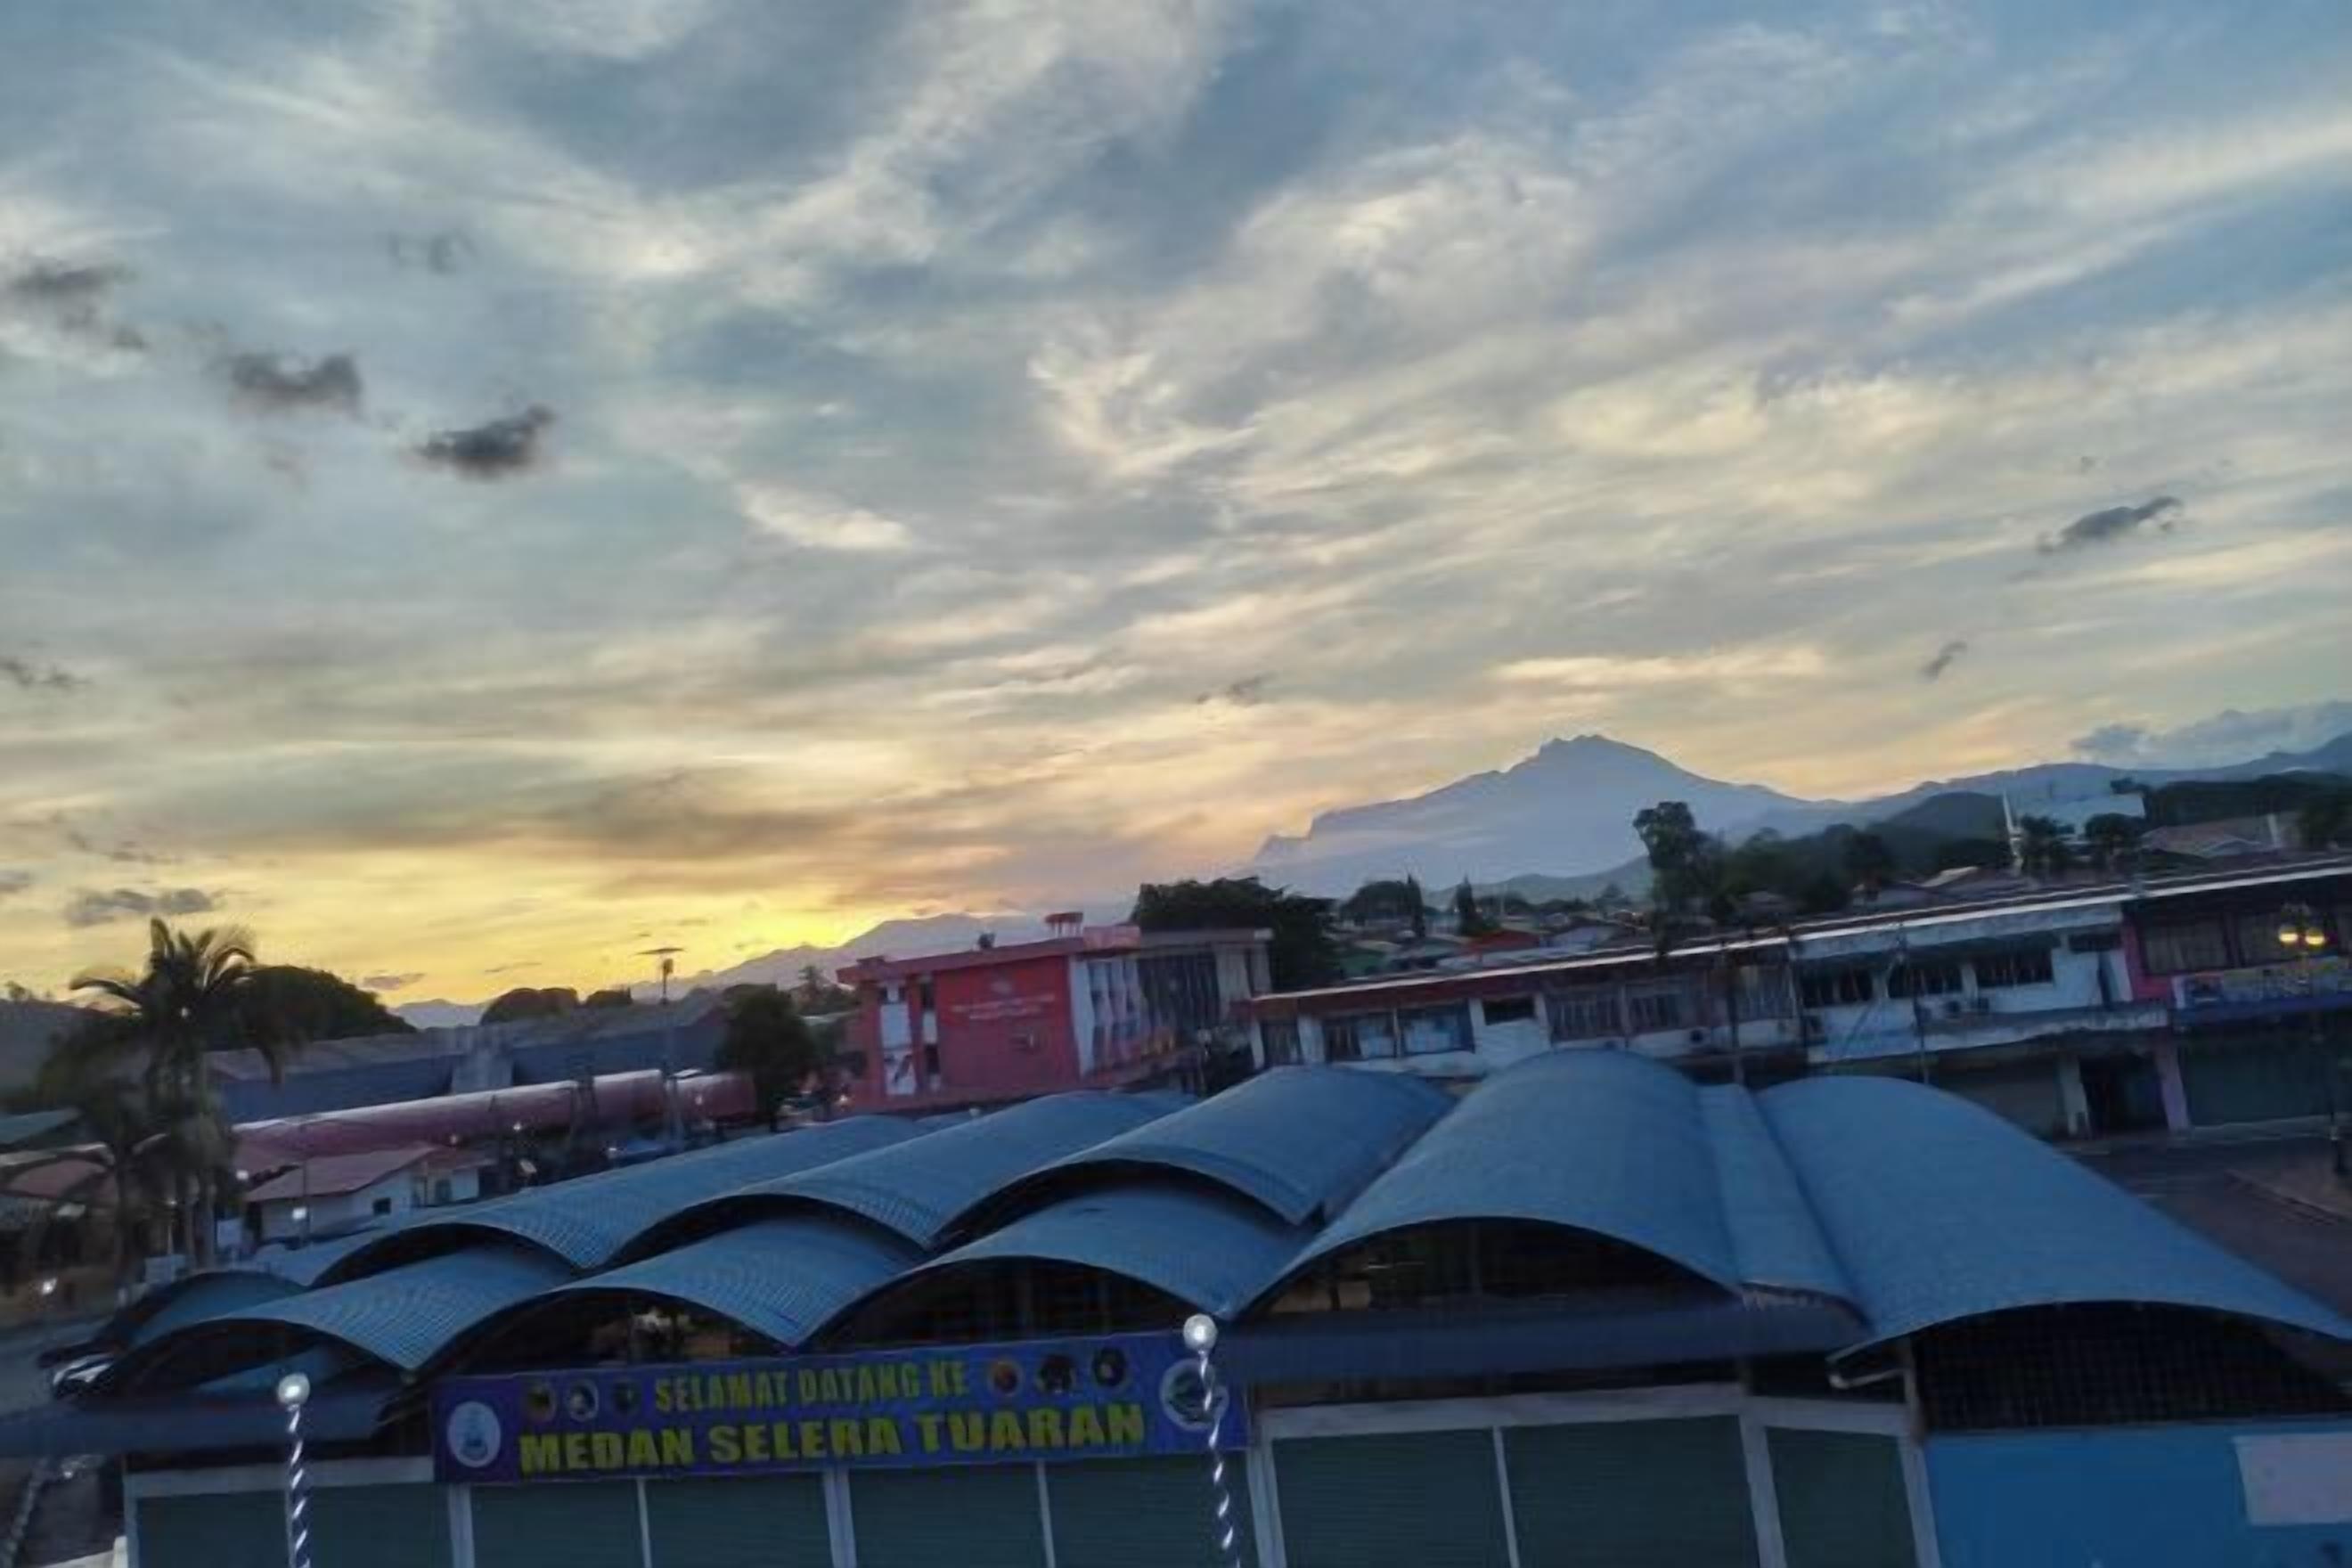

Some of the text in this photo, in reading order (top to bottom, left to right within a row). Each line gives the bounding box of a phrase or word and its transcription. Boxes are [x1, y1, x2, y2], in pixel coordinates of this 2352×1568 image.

[655, 1360, 967, 1411] SELAMAT DATANG KE
[519, 1403, 1144, 1473] MEDAN SELERA TUARAN
